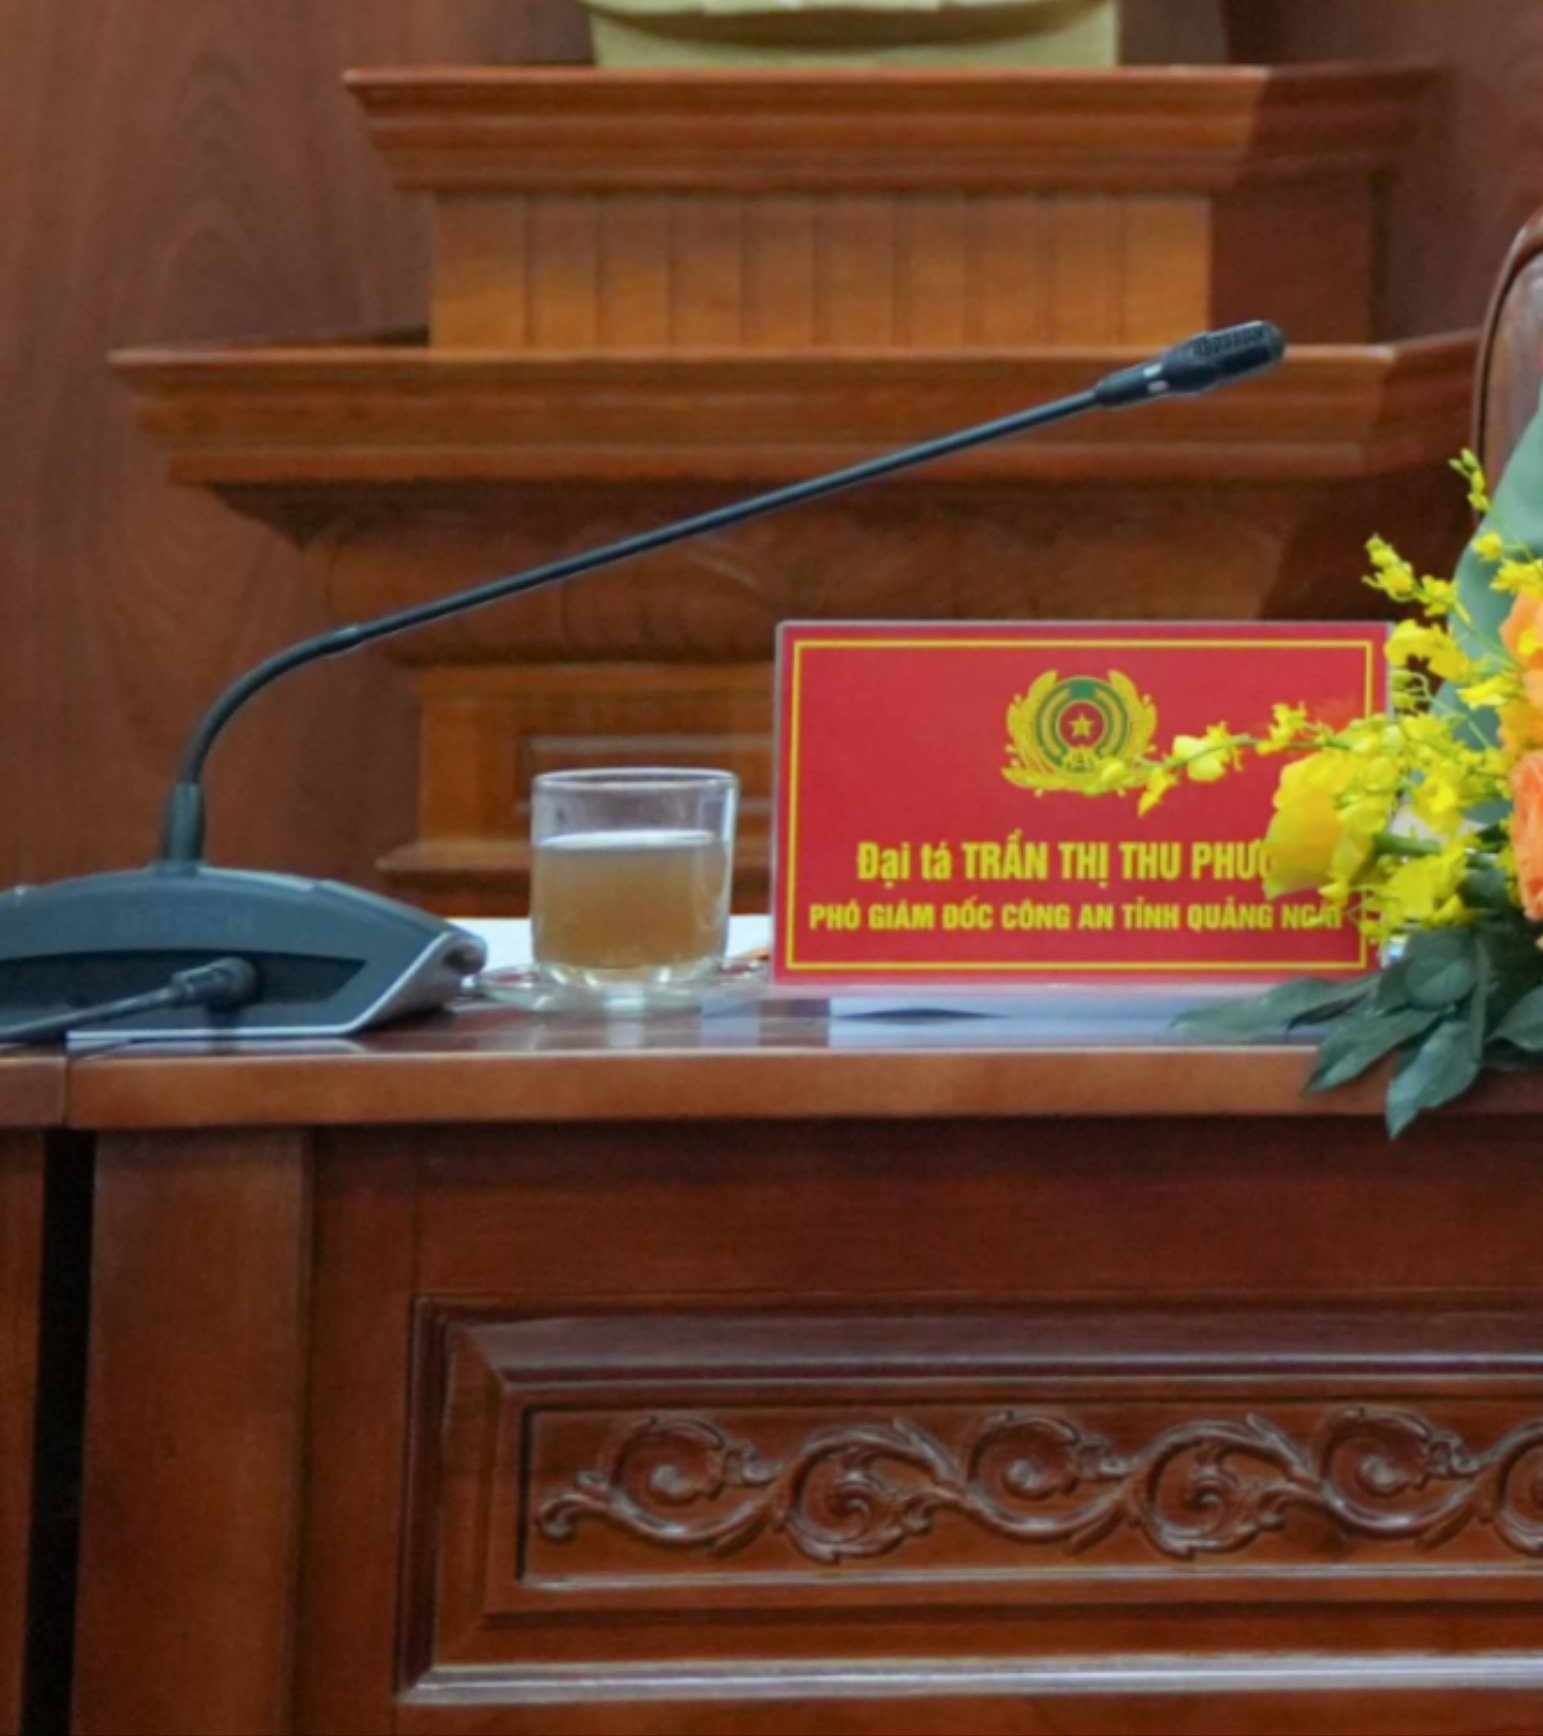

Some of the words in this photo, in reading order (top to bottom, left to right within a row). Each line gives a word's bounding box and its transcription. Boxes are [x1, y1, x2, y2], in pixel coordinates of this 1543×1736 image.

[857, 842, 910, 888] Đại
[921, 842, 952, 880] tá
[961, 829, 1048, 880] TRẦN
[1058, 842, 1109, 888] THỊ
[1119, 842, 1181, 880] THU
[810, 900, 861, 930] PHÓ
[868, 900, 935, 930] GIÁM
[942, 897, 993, 930] ĐỐC
[1001, 899, 1071, 930] CÔNG
[1078, 904, 1114, 929] AN
[1122, 897, 1180, 929] TỈNH
[1187, 896, 1274, 932] QUẢNG
